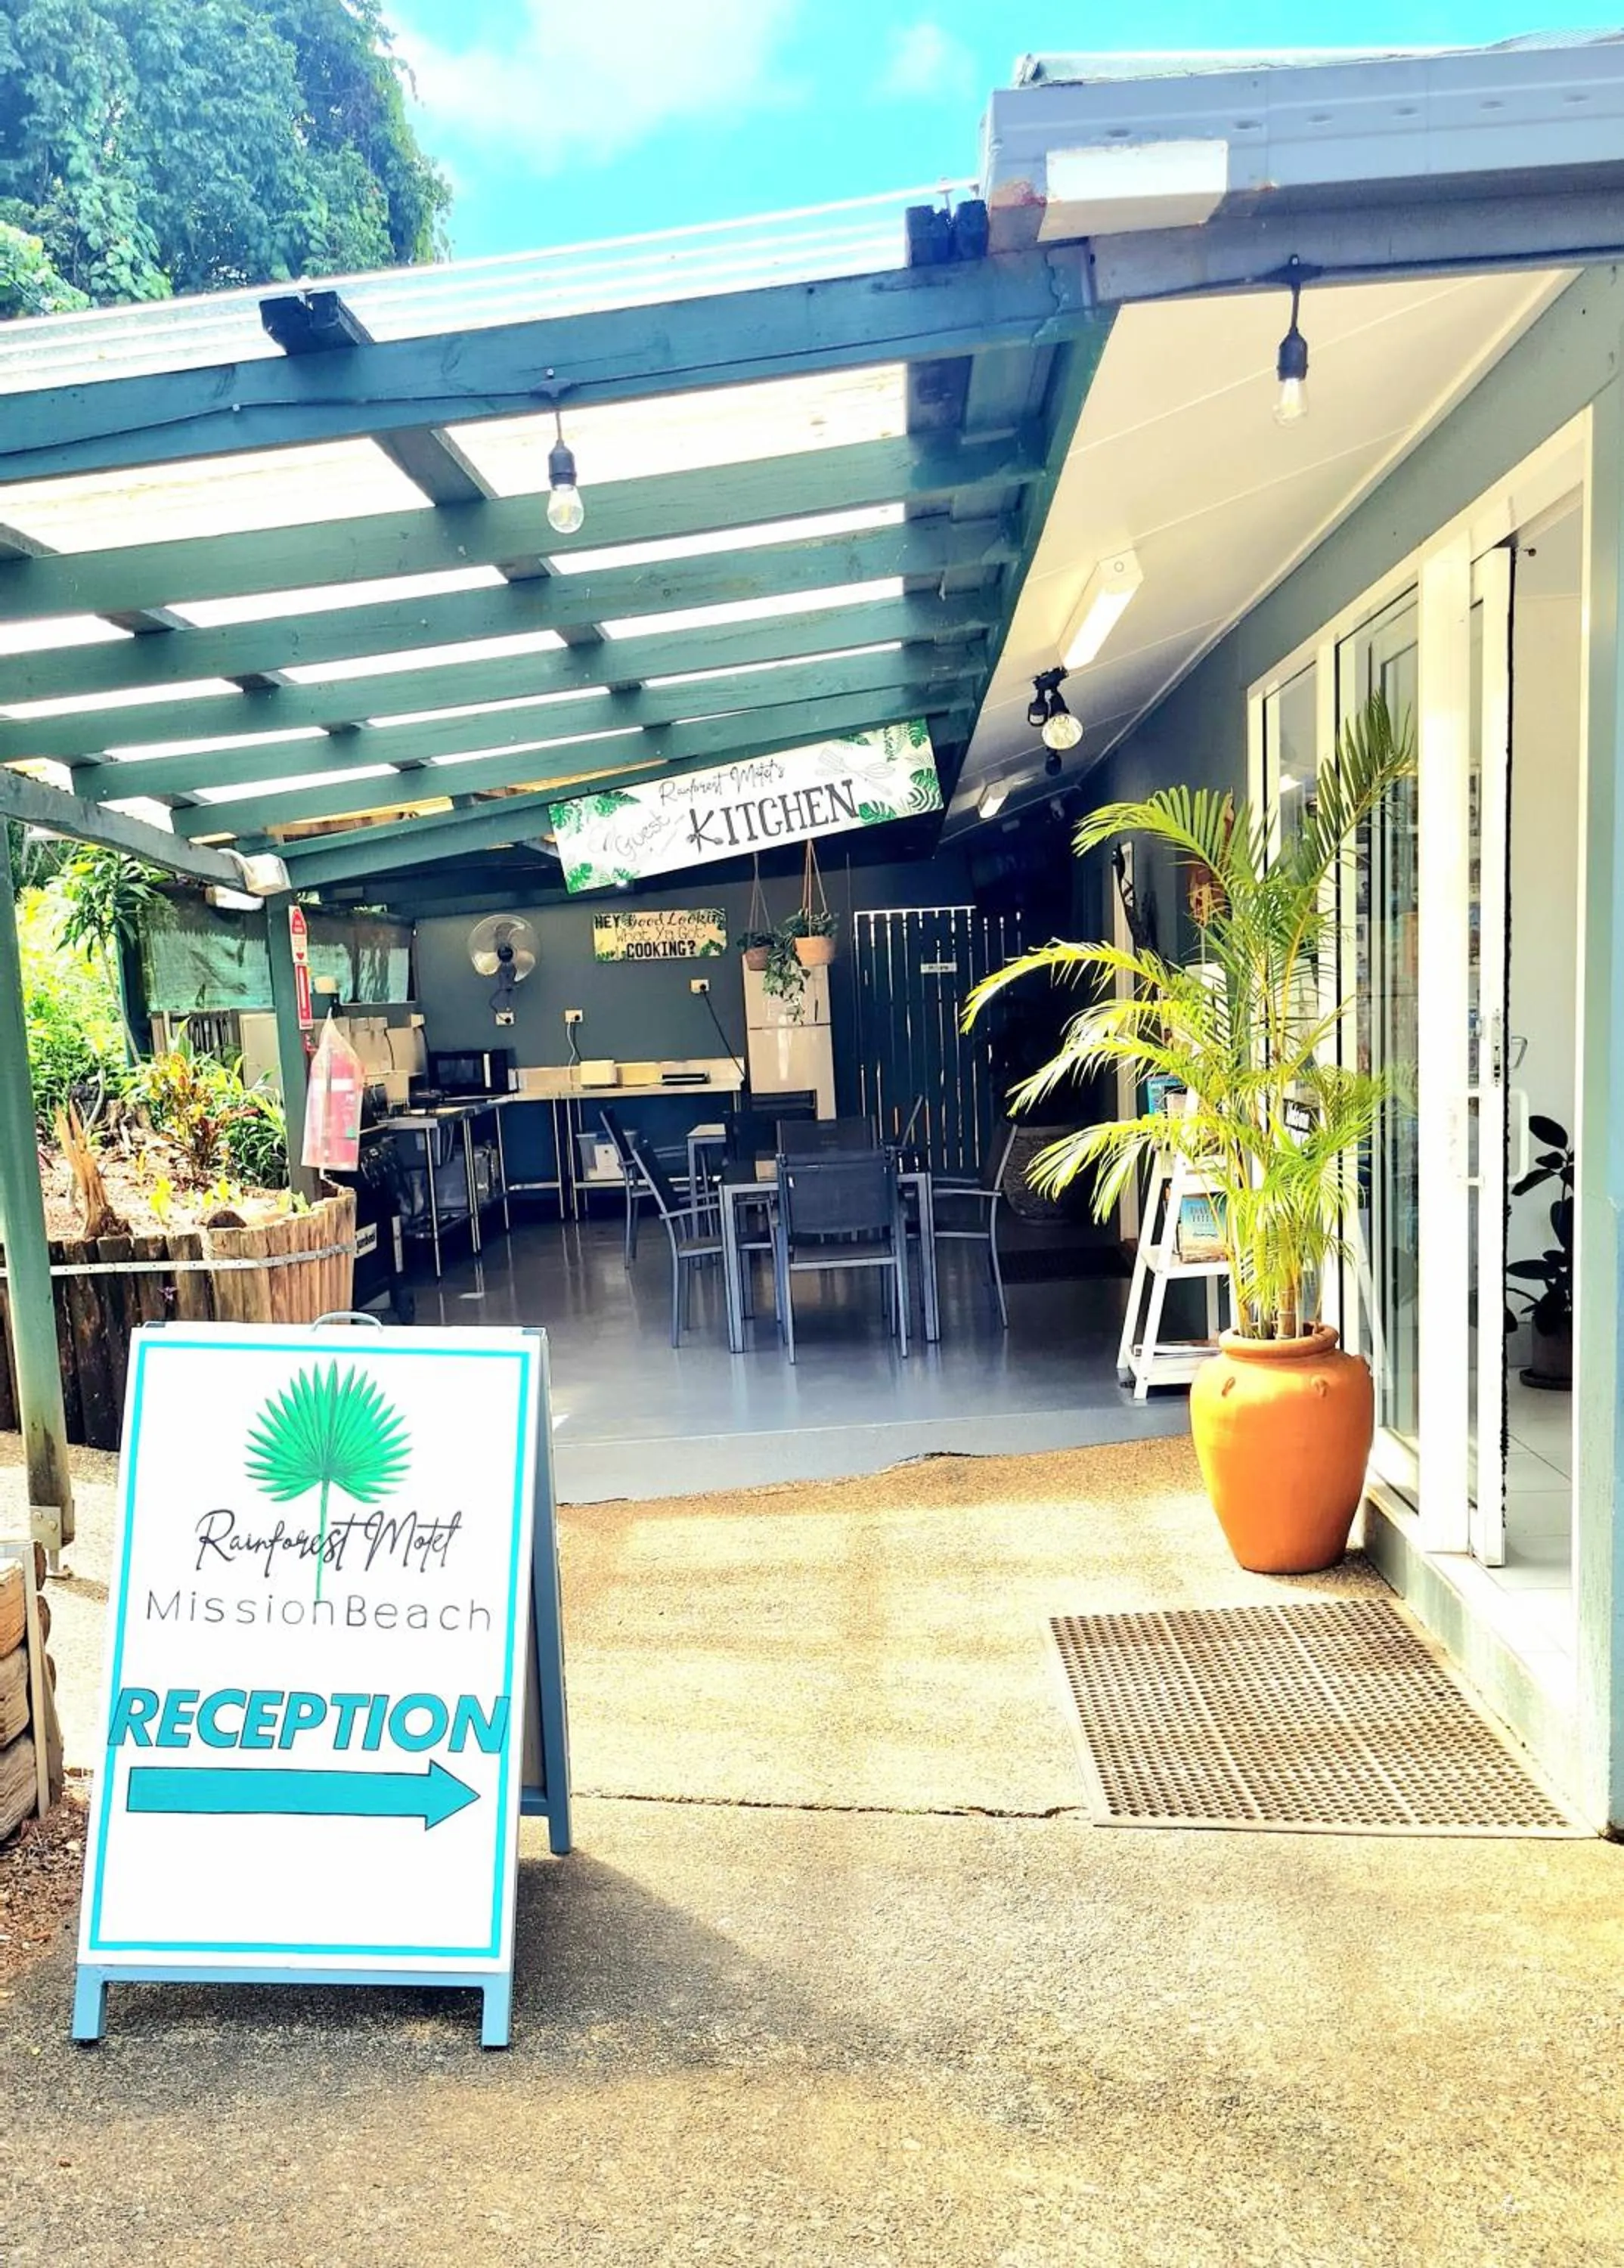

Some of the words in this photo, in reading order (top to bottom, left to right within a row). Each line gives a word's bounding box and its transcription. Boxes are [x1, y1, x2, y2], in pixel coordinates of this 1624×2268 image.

[659, 771, 729, 807] Rainforest
[686, 779, 860, 854] KITCHEN
[626, 940, 696, 958] COOKING?
[194, 1509, 365, 1577] Rainforest
[363, 1510, 463, 1573] Motel
[107, 1688, 510, 1754] RECEPTION
